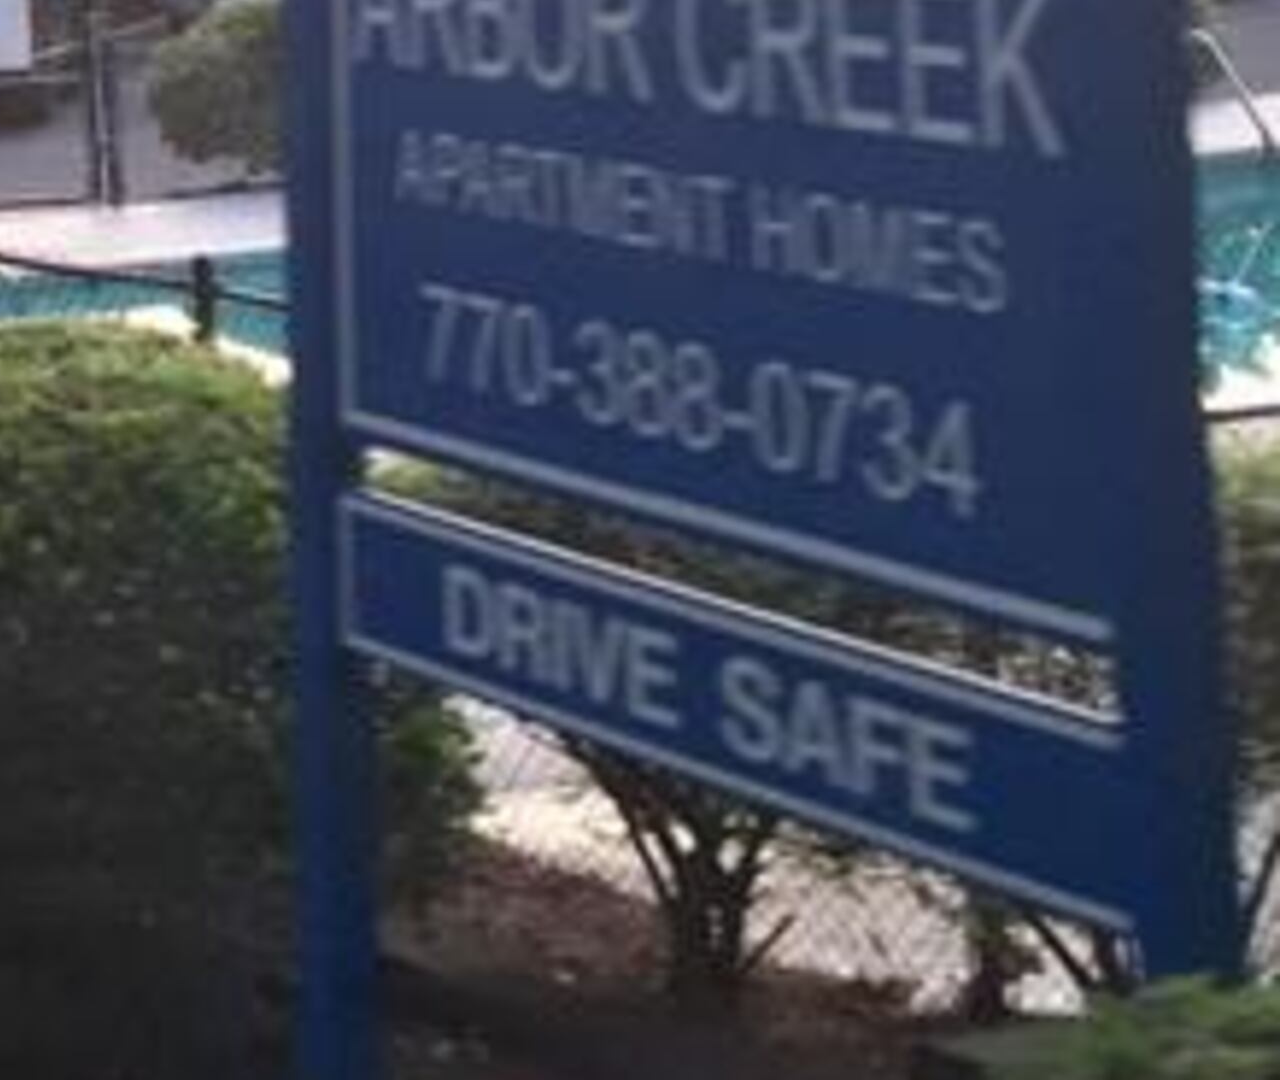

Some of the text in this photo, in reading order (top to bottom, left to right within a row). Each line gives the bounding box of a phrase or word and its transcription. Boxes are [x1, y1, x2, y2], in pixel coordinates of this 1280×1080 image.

[396, 132, 1007, 312] APARTMENT HOMES
[422, 285, 979, 512] 770-388-0734
[446, 570, 977, 830] DRIVE SAFE
